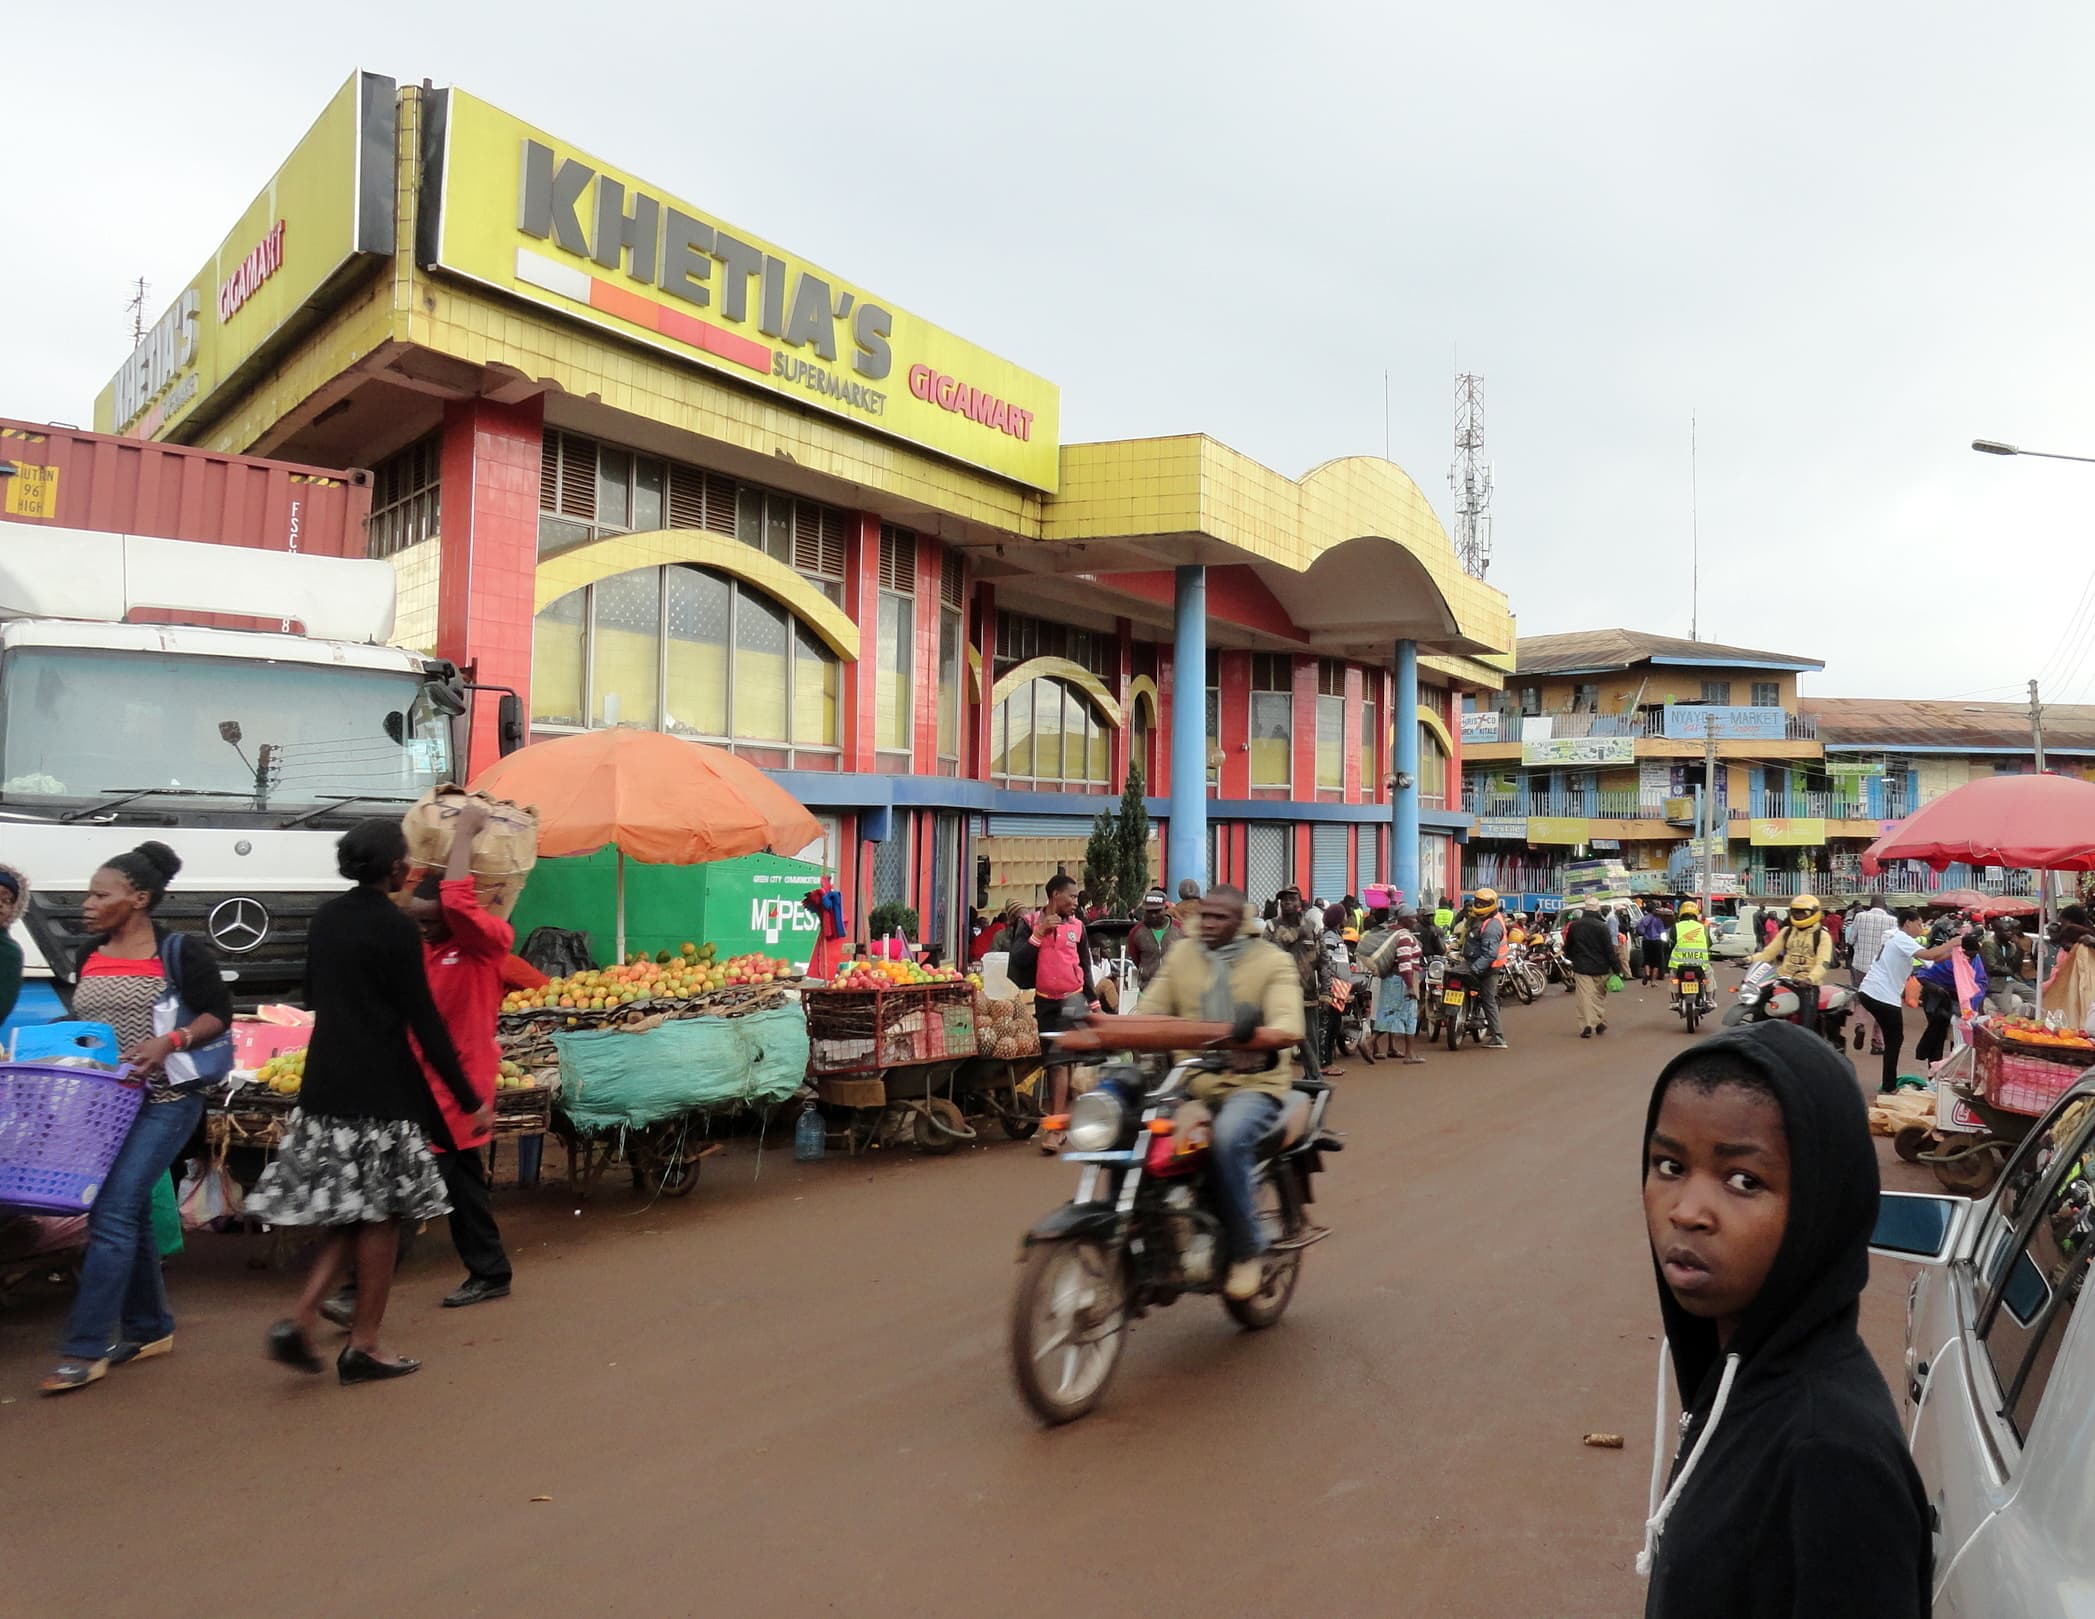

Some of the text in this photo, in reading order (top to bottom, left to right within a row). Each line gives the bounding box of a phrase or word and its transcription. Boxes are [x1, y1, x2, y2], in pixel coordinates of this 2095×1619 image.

[219, 219, 286, 325] GIGAMART
[518, 138, 893, 380] KHETIA'S
[772, 350, 887, 416] SUPERMARKET
[909, 363, 1034, 442] GIGAMART
[289, 501, 300, 554] FSC
[1730, 711, 1779, 725] MARKET
